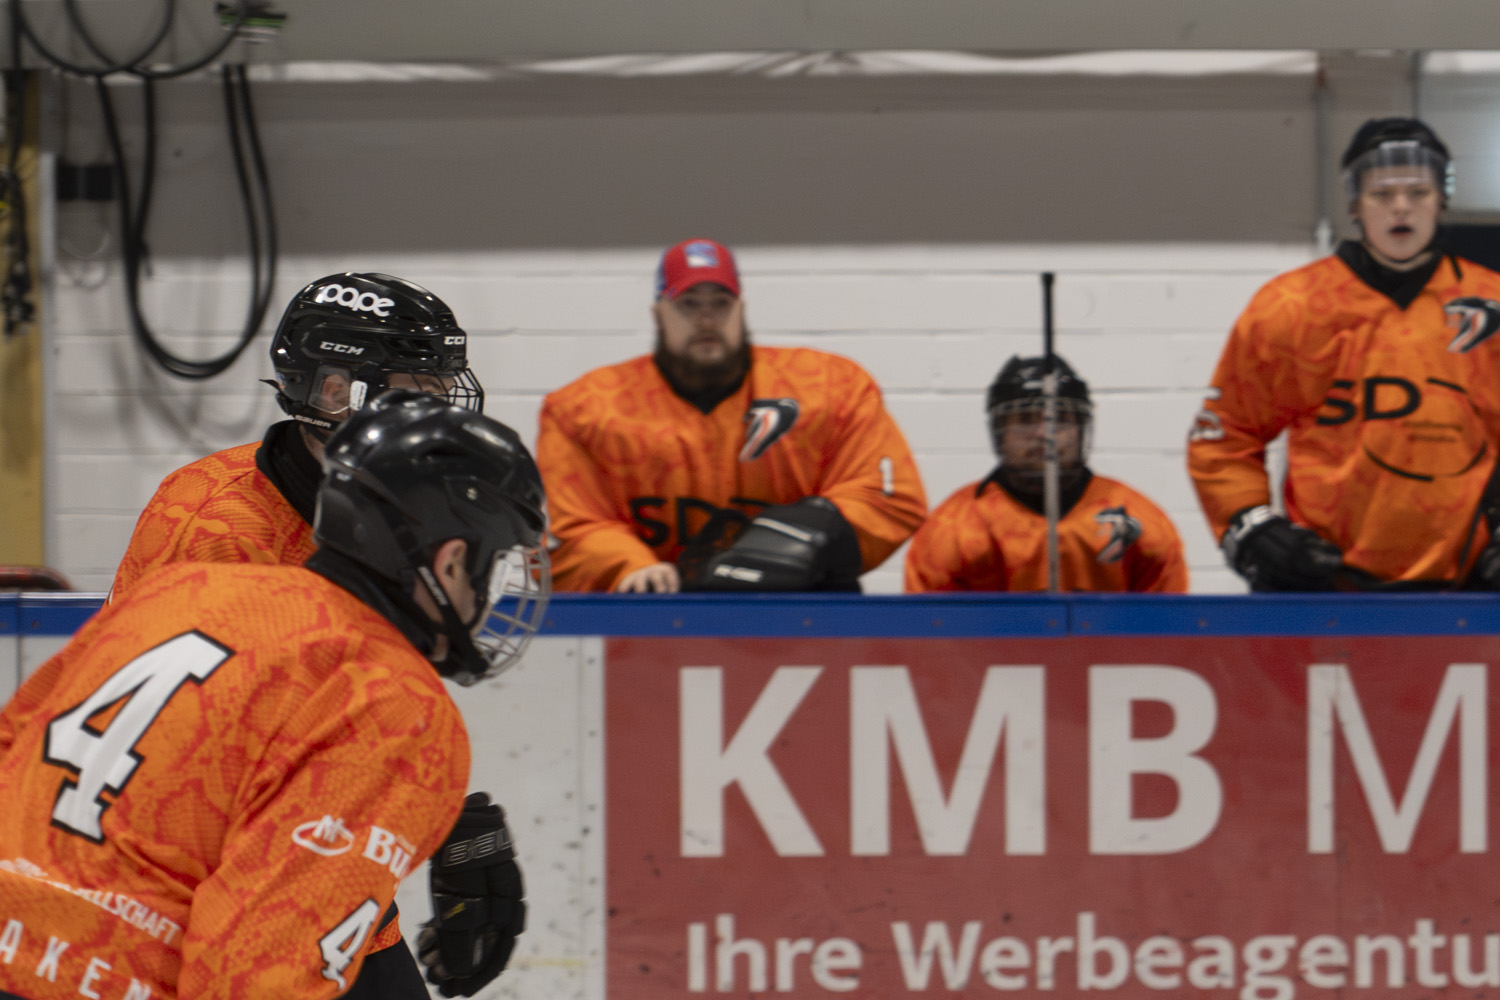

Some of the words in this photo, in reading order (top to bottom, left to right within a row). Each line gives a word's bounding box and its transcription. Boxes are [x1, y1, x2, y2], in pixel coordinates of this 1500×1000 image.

[319, 341, 365, 355] CCM
[43, 629, 236, 846] 4
[679, 663, 1223, 857] KMB
[319, 898, 382, 990] 4
[686, 913, 863, 993] Ihre
